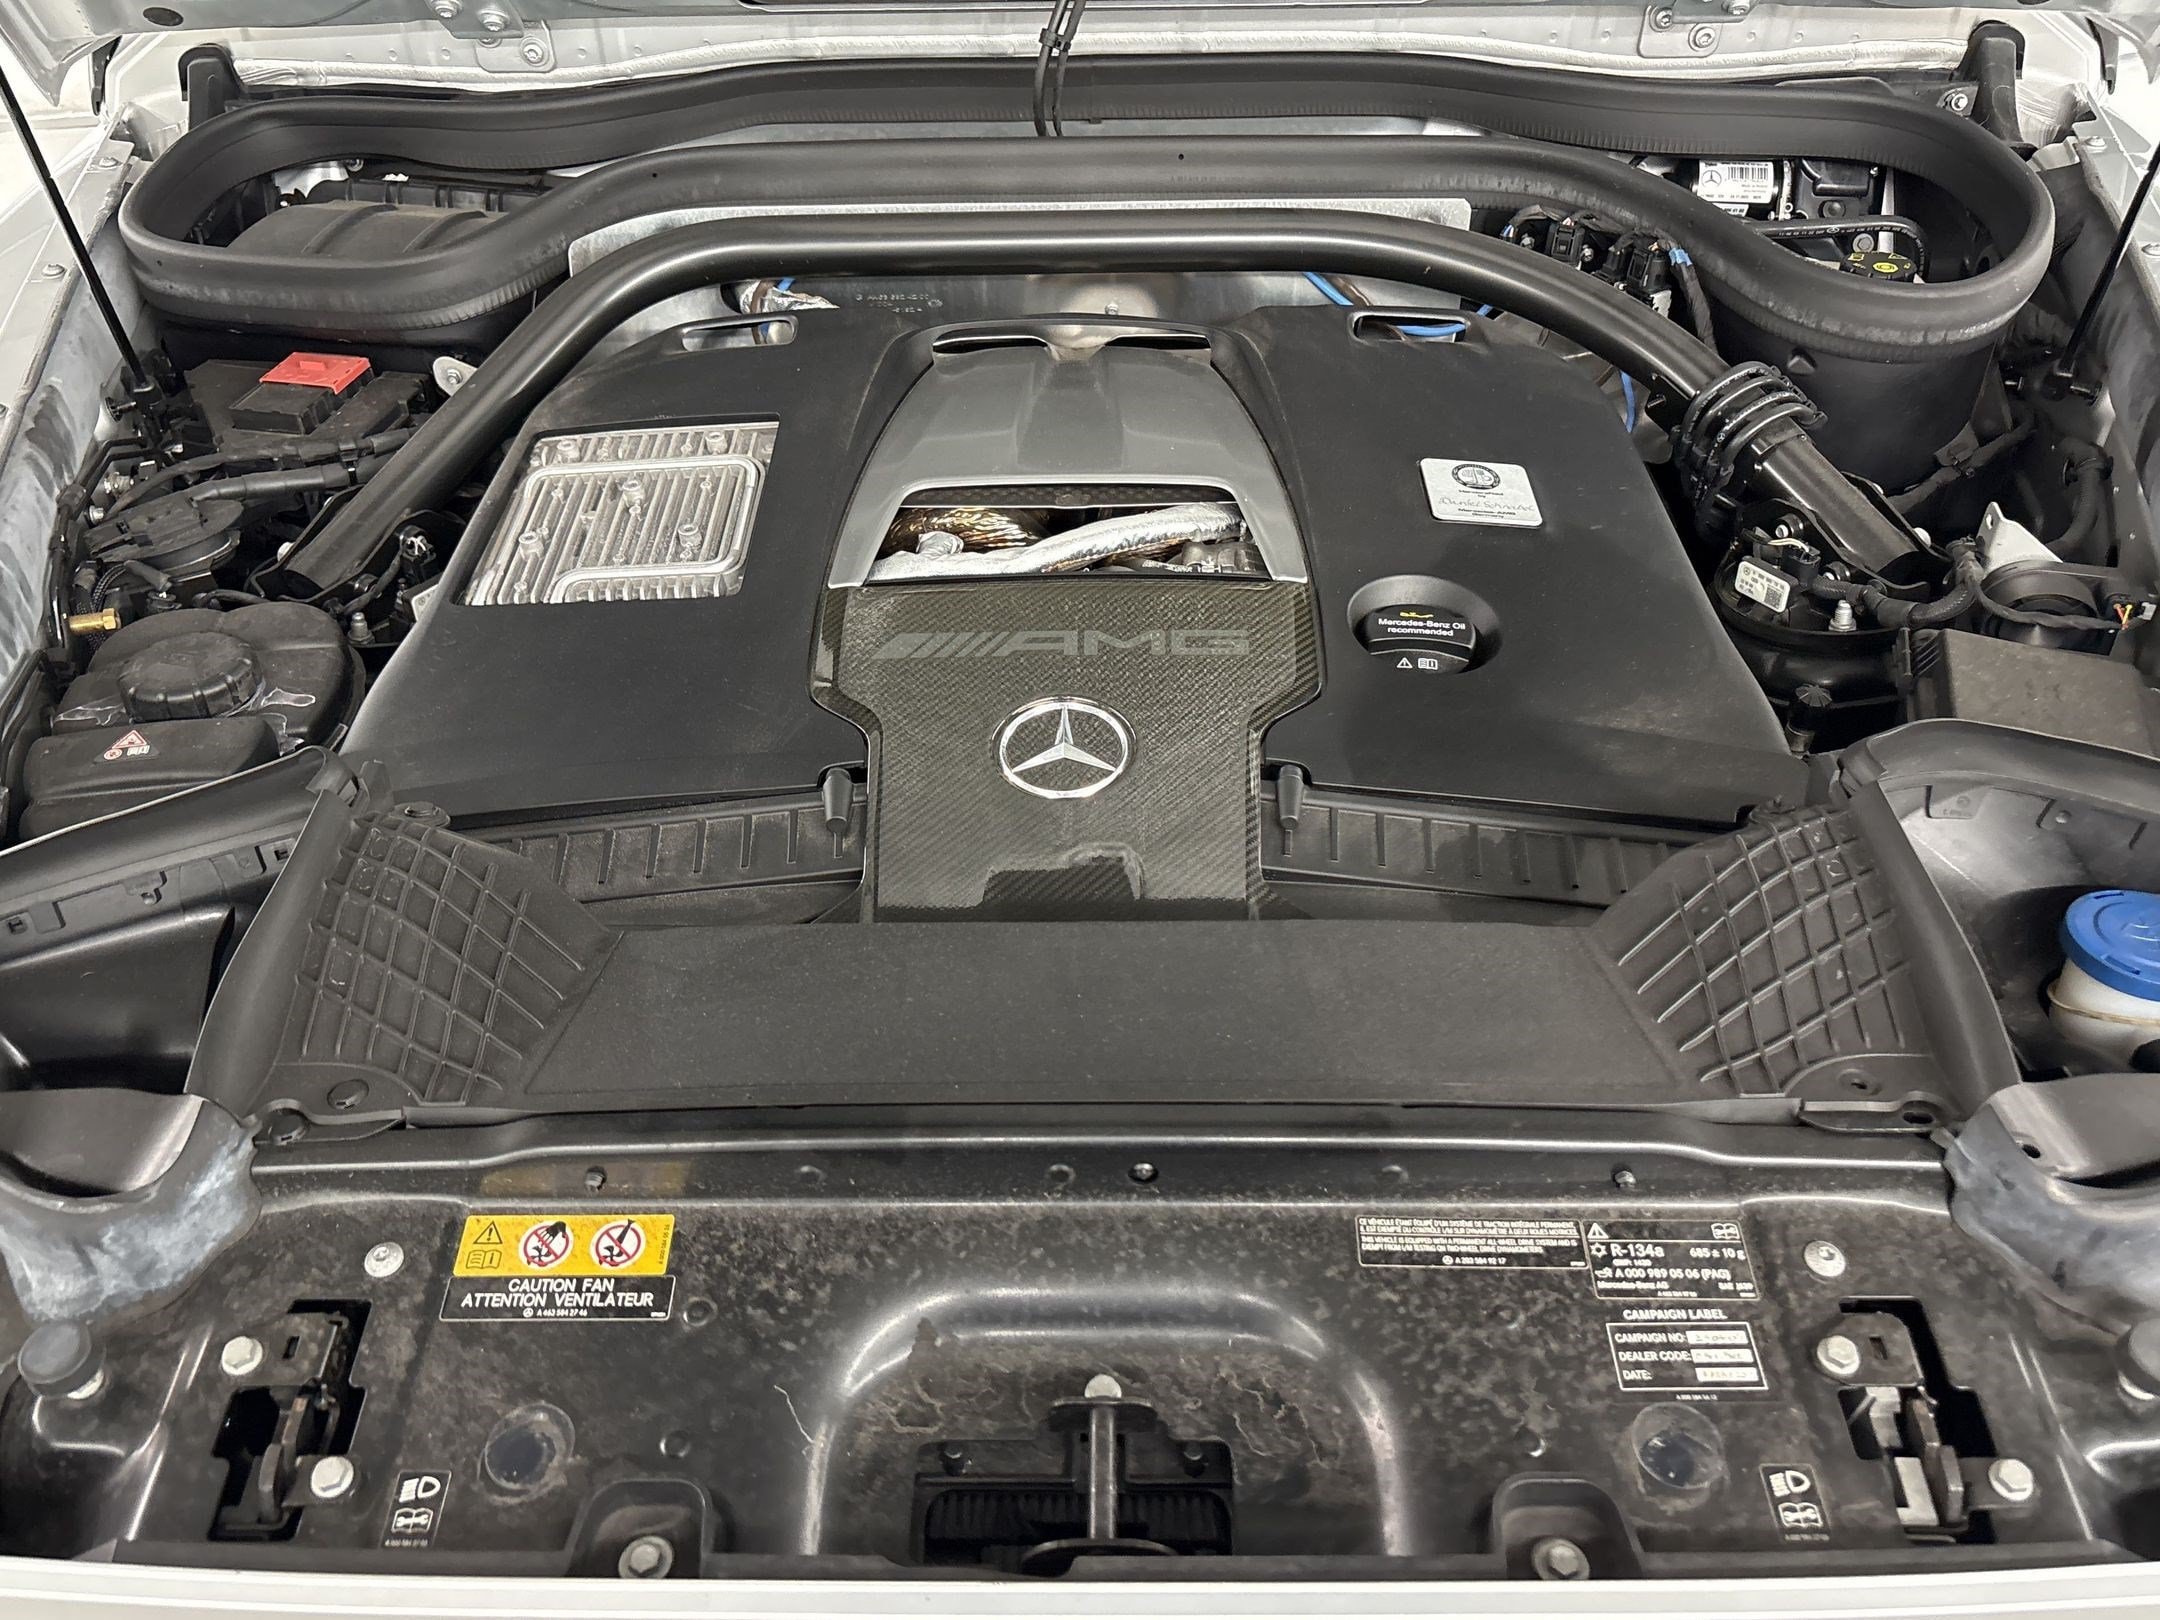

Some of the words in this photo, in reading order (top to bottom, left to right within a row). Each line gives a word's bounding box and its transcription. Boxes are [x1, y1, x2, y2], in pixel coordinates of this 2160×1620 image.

[1378, 618, 1450, 629] Mercedes-Benz
[1452, 622, 1466, 630] Oil
[1387, 627, 1454, 636] recommended
[994, 629, 1250, 657] AMG
[1610, 1243, 1665, 1257] R-134a
[1689, 1247, 1711, 1258] 685
[1721, 1247, 1736, 1258] 10
[1736, 1249, 1746, 1261] g
[1615, 1268, 1625, 1278] A
[1624, 1268, 1646, 1278] 000
[1646, 1268, 1668, 1278] 989
[1669, 1268, 1684, 1279] 05
[1684, 1268, 1700, 1279] 06
[1700, 1268, 1732, 1281] (PAG)
[508, 1278, 577, 1292] CAUTION
[582, 1278, 615, 1292] FAN
[461, 1292, 548, 1307] ATTENTION
[555, 1292, 654, 1307] VENTILATEUR
[1623, 1309, 1687, 1320] CAMPAIGN
[1687, 1308, 1728, 1320] LABEL
[1615, 1332, 1667, 1343] CAMPAIGN
[1667, 1332, 1687, 1343] NO:
[1618, 1351, 1659, 1361] DEALER
[1659, 1350, 1692, 1361] CODE:
[1622, 1369, 1653, 1380] DATE:
